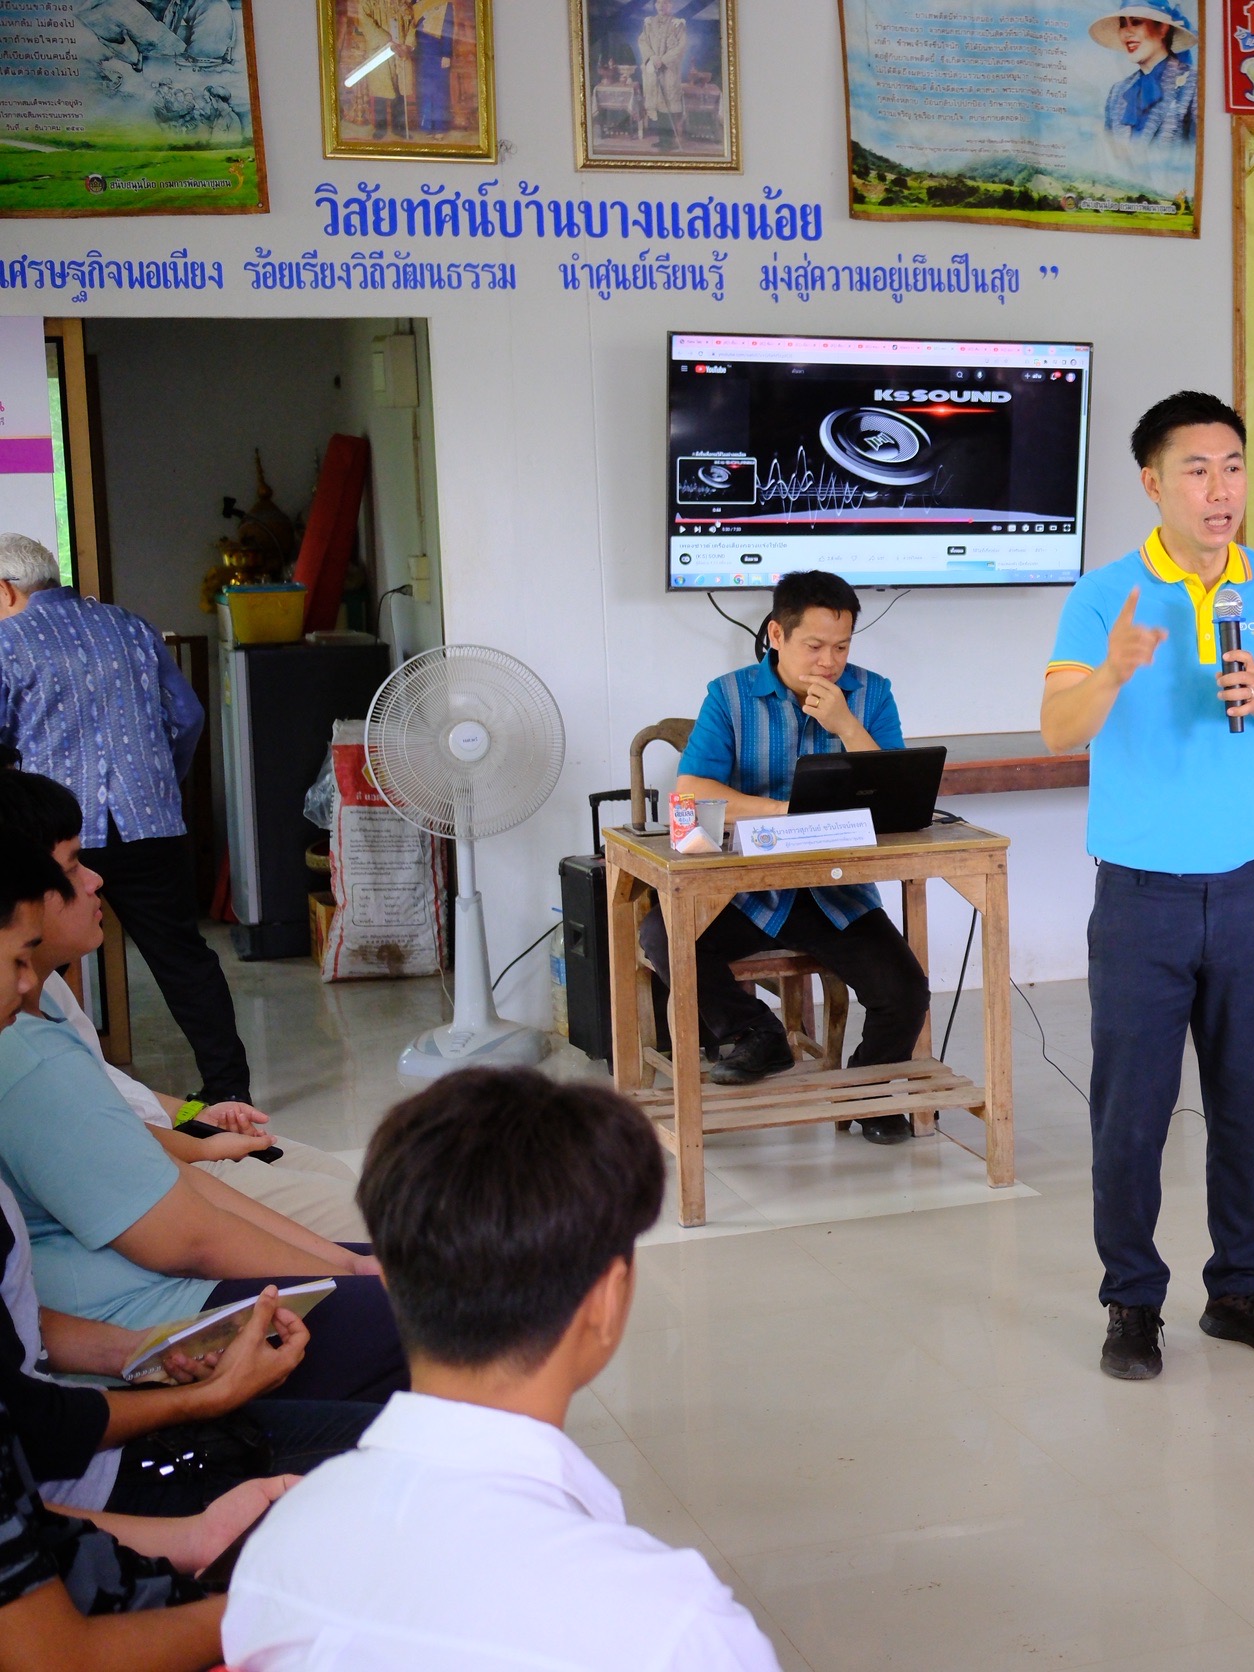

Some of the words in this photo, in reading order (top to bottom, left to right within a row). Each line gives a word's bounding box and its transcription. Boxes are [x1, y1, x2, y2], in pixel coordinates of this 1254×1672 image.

[315, 178, 823, 242] วิสัยทัศน์บ้านบางแสมน้อย
[243, 246, 517, 291] ร้อยเรียงวิถีวัฒนธรรม
[558, 248, 728, 301] นำศูนย์เรียนรู้
[759, 251, 1020, 305] มุ่งสู่ความอยู่เย็นเป็นสุข
[706, 365, 727, 375] YouTube
